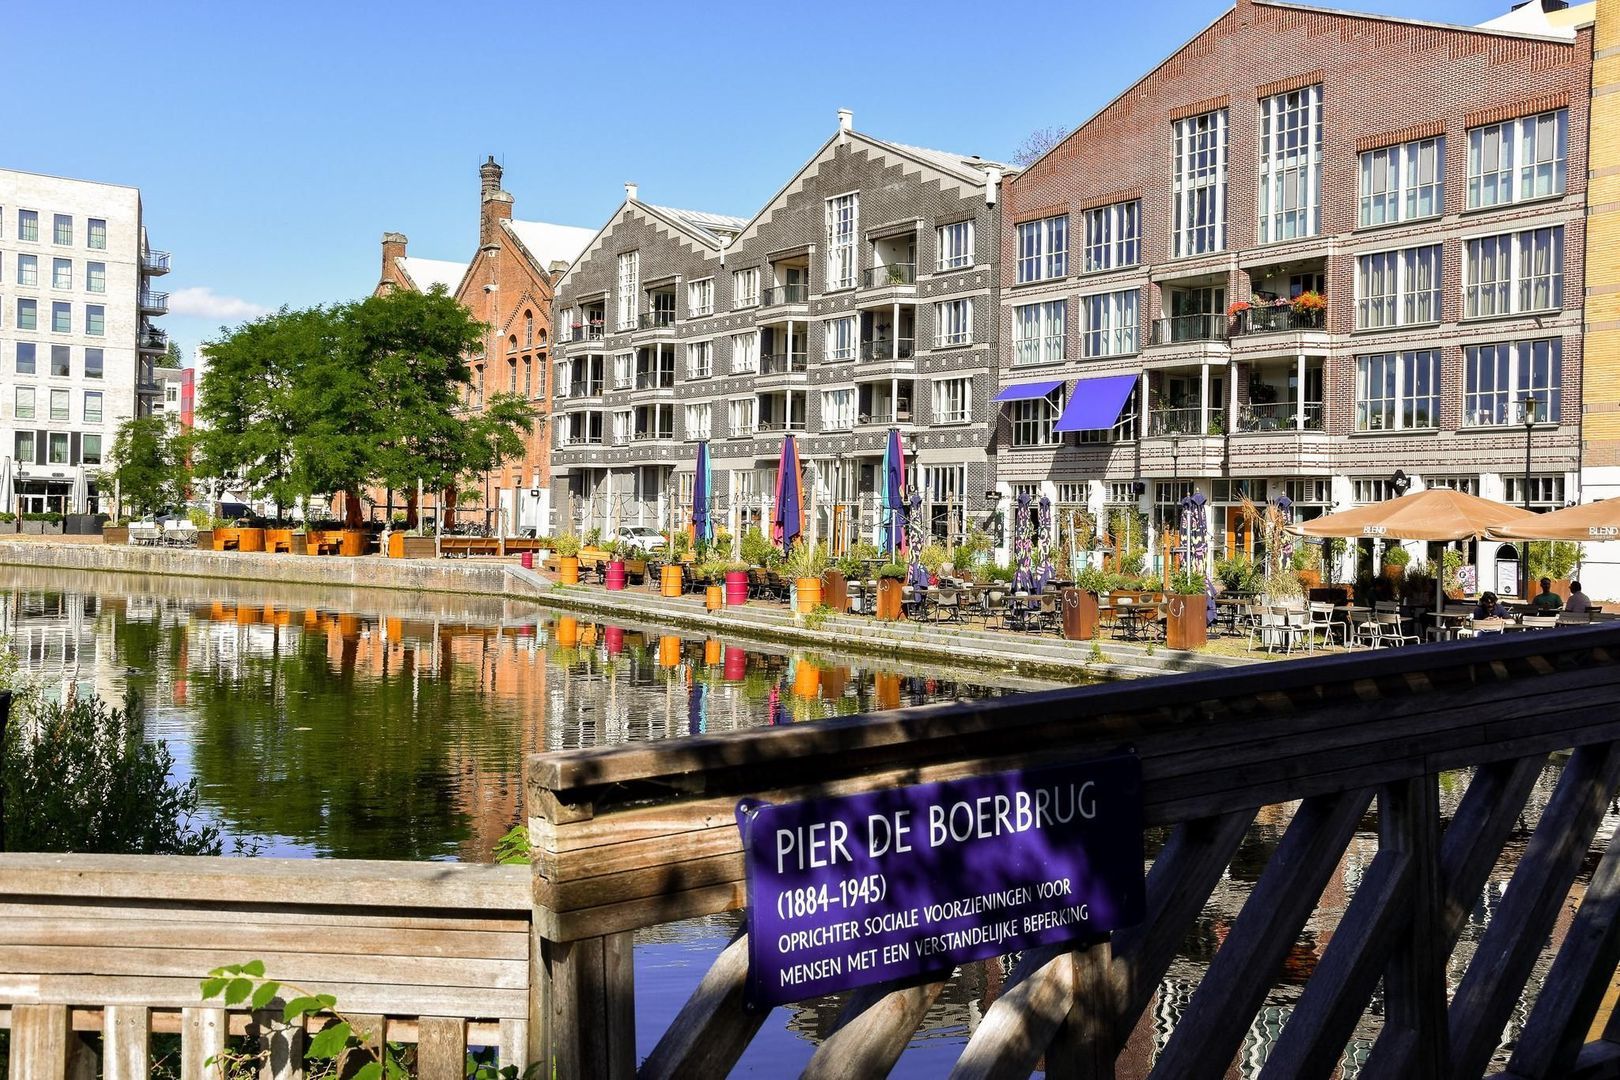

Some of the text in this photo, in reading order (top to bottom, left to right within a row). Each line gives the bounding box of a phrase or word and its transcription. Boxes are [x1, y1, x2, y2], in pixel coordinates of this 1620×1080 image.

[1589, 526, 1619, 535] BLEND
[776, 781, 1096, 874] PIER DE BOERBRUG
[777, 874, 887, 920] (1884-1945)
[778, 878, 1072, 953] OPRICHTER SOCIALE VOORZIENINGEN VOOR
[780, 904, 1089, 987] MENSEN MET EEN VERSTANDELIJKE BEPERKING
